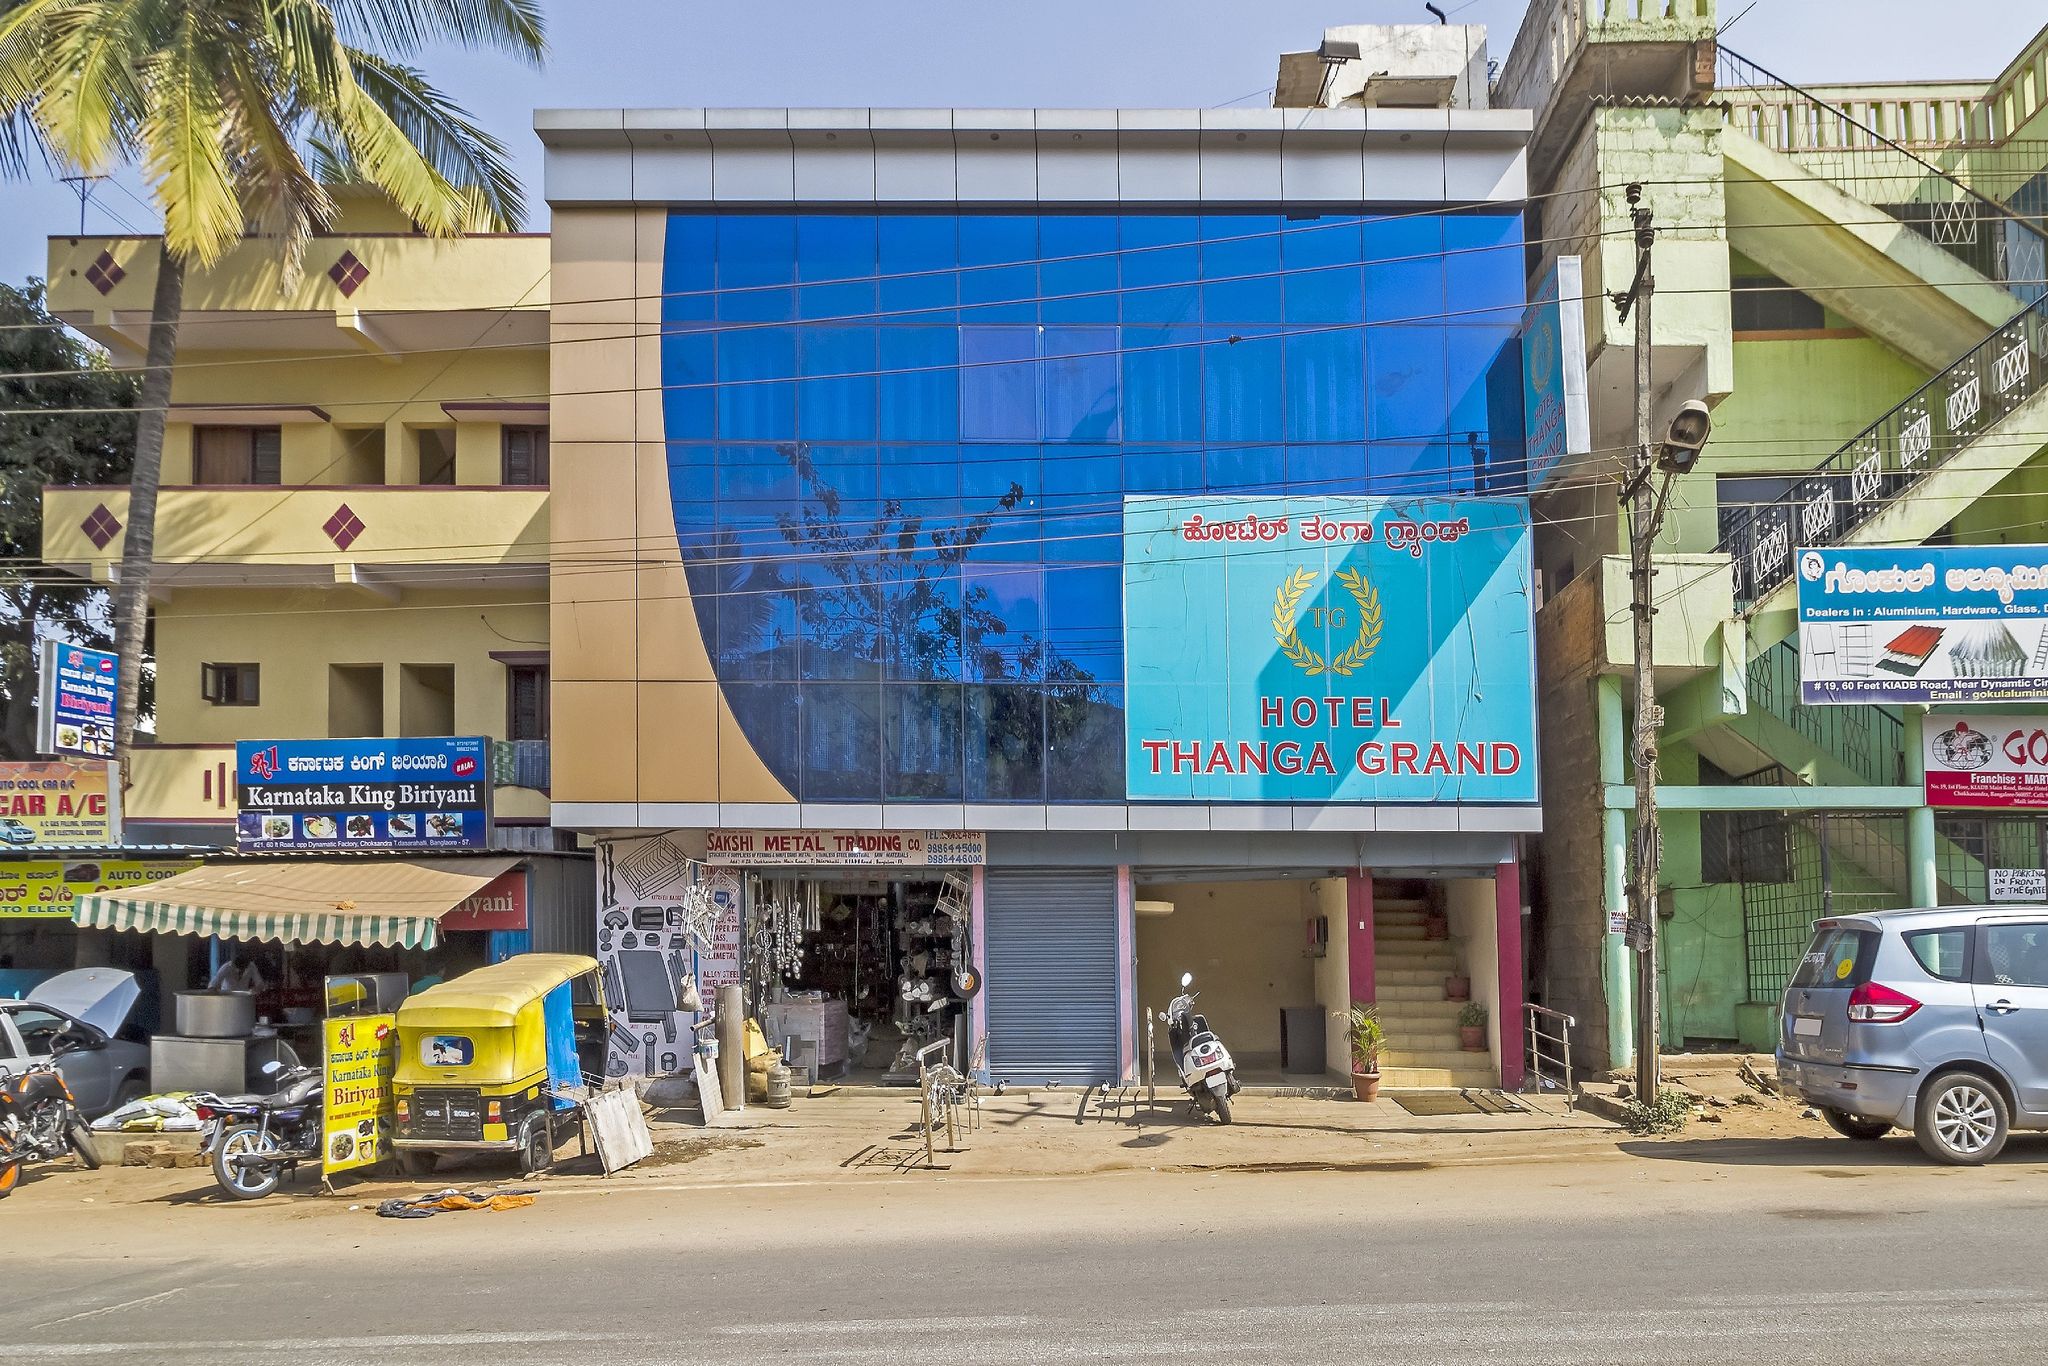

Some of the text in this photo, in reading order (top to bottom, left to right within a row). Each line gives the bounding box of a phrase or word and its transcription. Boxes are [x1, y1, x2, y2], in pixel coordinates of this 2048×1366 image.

[1534, 392, 1554, 423] HOTEL
[1528, 402, 1565, 452] THANGA
[1531, 432, 1562, 480] GRAND
[1183, 514, 1288, 543] ಹೋಟೆಲ್
[1300, 515, 1374, 543] ತಂಗಾ
[1806, 608, 1849, 617] Dealers
[1853, 608, 1864, 616] in
[1874, 606, 1939, 617] Aluminium,
[1943, 606, 2001, 616] Hardware,
[2004, 605, 2040, 614] Glass,
[1824, 682, 1839, 691] 19,
[1841, 682, 1854, 690] 60
[1857, 682, 1880, 690] Feet
[1883, 681, 1918, 690] KIADB
[1920, 680, 1951, 690] Road,
[1954, 680, 1979, 689] Near
[1930, 691, 1962, 699] Email
[61, 693, 112, 715] Biriyani
[1261, 697, 1401, 727] HOTEL
[288, 752, 448, 772] ಕರ್ನಾಟಕ ಕಿಂಗ್ ಬಿರಿಯಾನಿ
[1142, 740, 1521, 775] THANGA GRAND
[17, 780, 40, 789] COOL
[1971, 773, 2016, 784] Franchise
[56, 793, 106, 818] A/C
[248, 784, 476, 811] Karnataka King Biriyani
[707, 832, 922, 851] SAKSHI METAL TRADING CO.
[927, 843, 981, 854] 9886445000
[108, 871, 142, 880] AUTO
[1994, 878, 2041, 887] IN FRONT
[1995, 870, 2008, 878] NO
[1995, 887, 2005, 895] OF
[2008, 886, 2024, 894] THE
[332, 1066, 371, 1083] Karnataka
[334, 1084, 389, 1106] Biriyani
